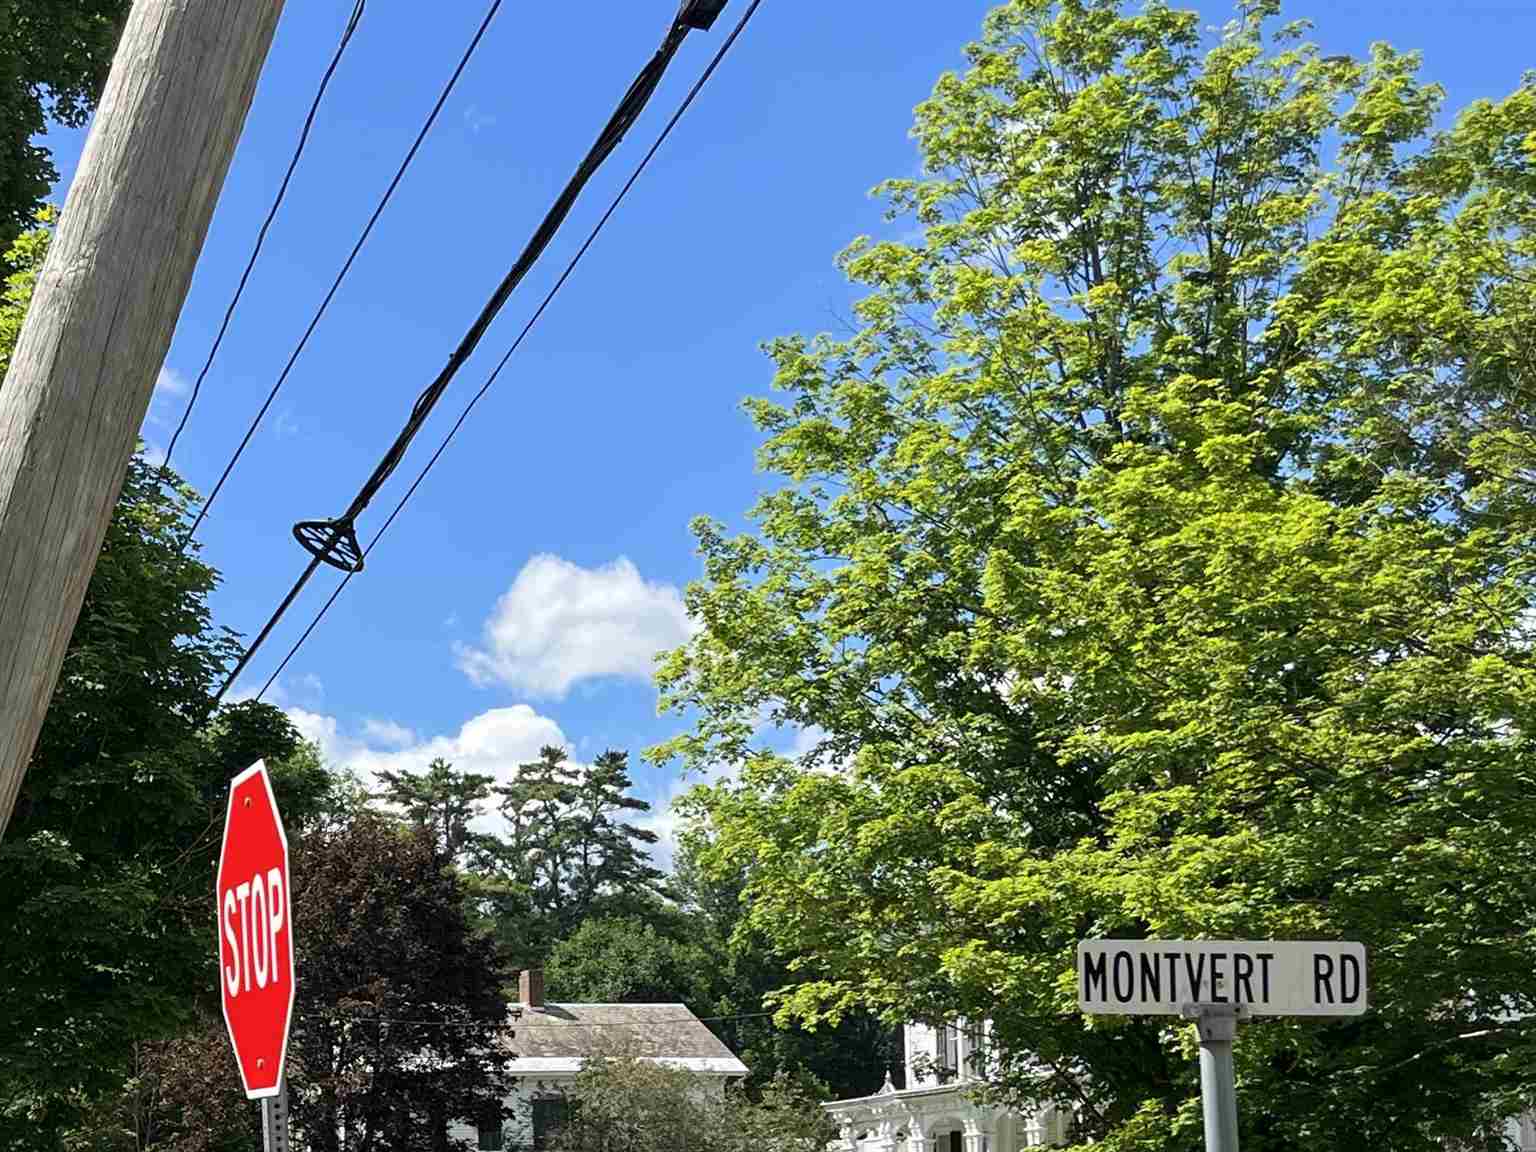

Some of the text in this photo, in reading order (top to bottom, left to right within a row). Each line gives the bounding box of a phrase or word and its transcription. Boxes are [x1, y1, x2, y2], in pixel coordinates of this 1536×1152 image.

[224, 867, 284, 997] STOP
[1083, 950, 1361, 1004] MONTVERT RD
